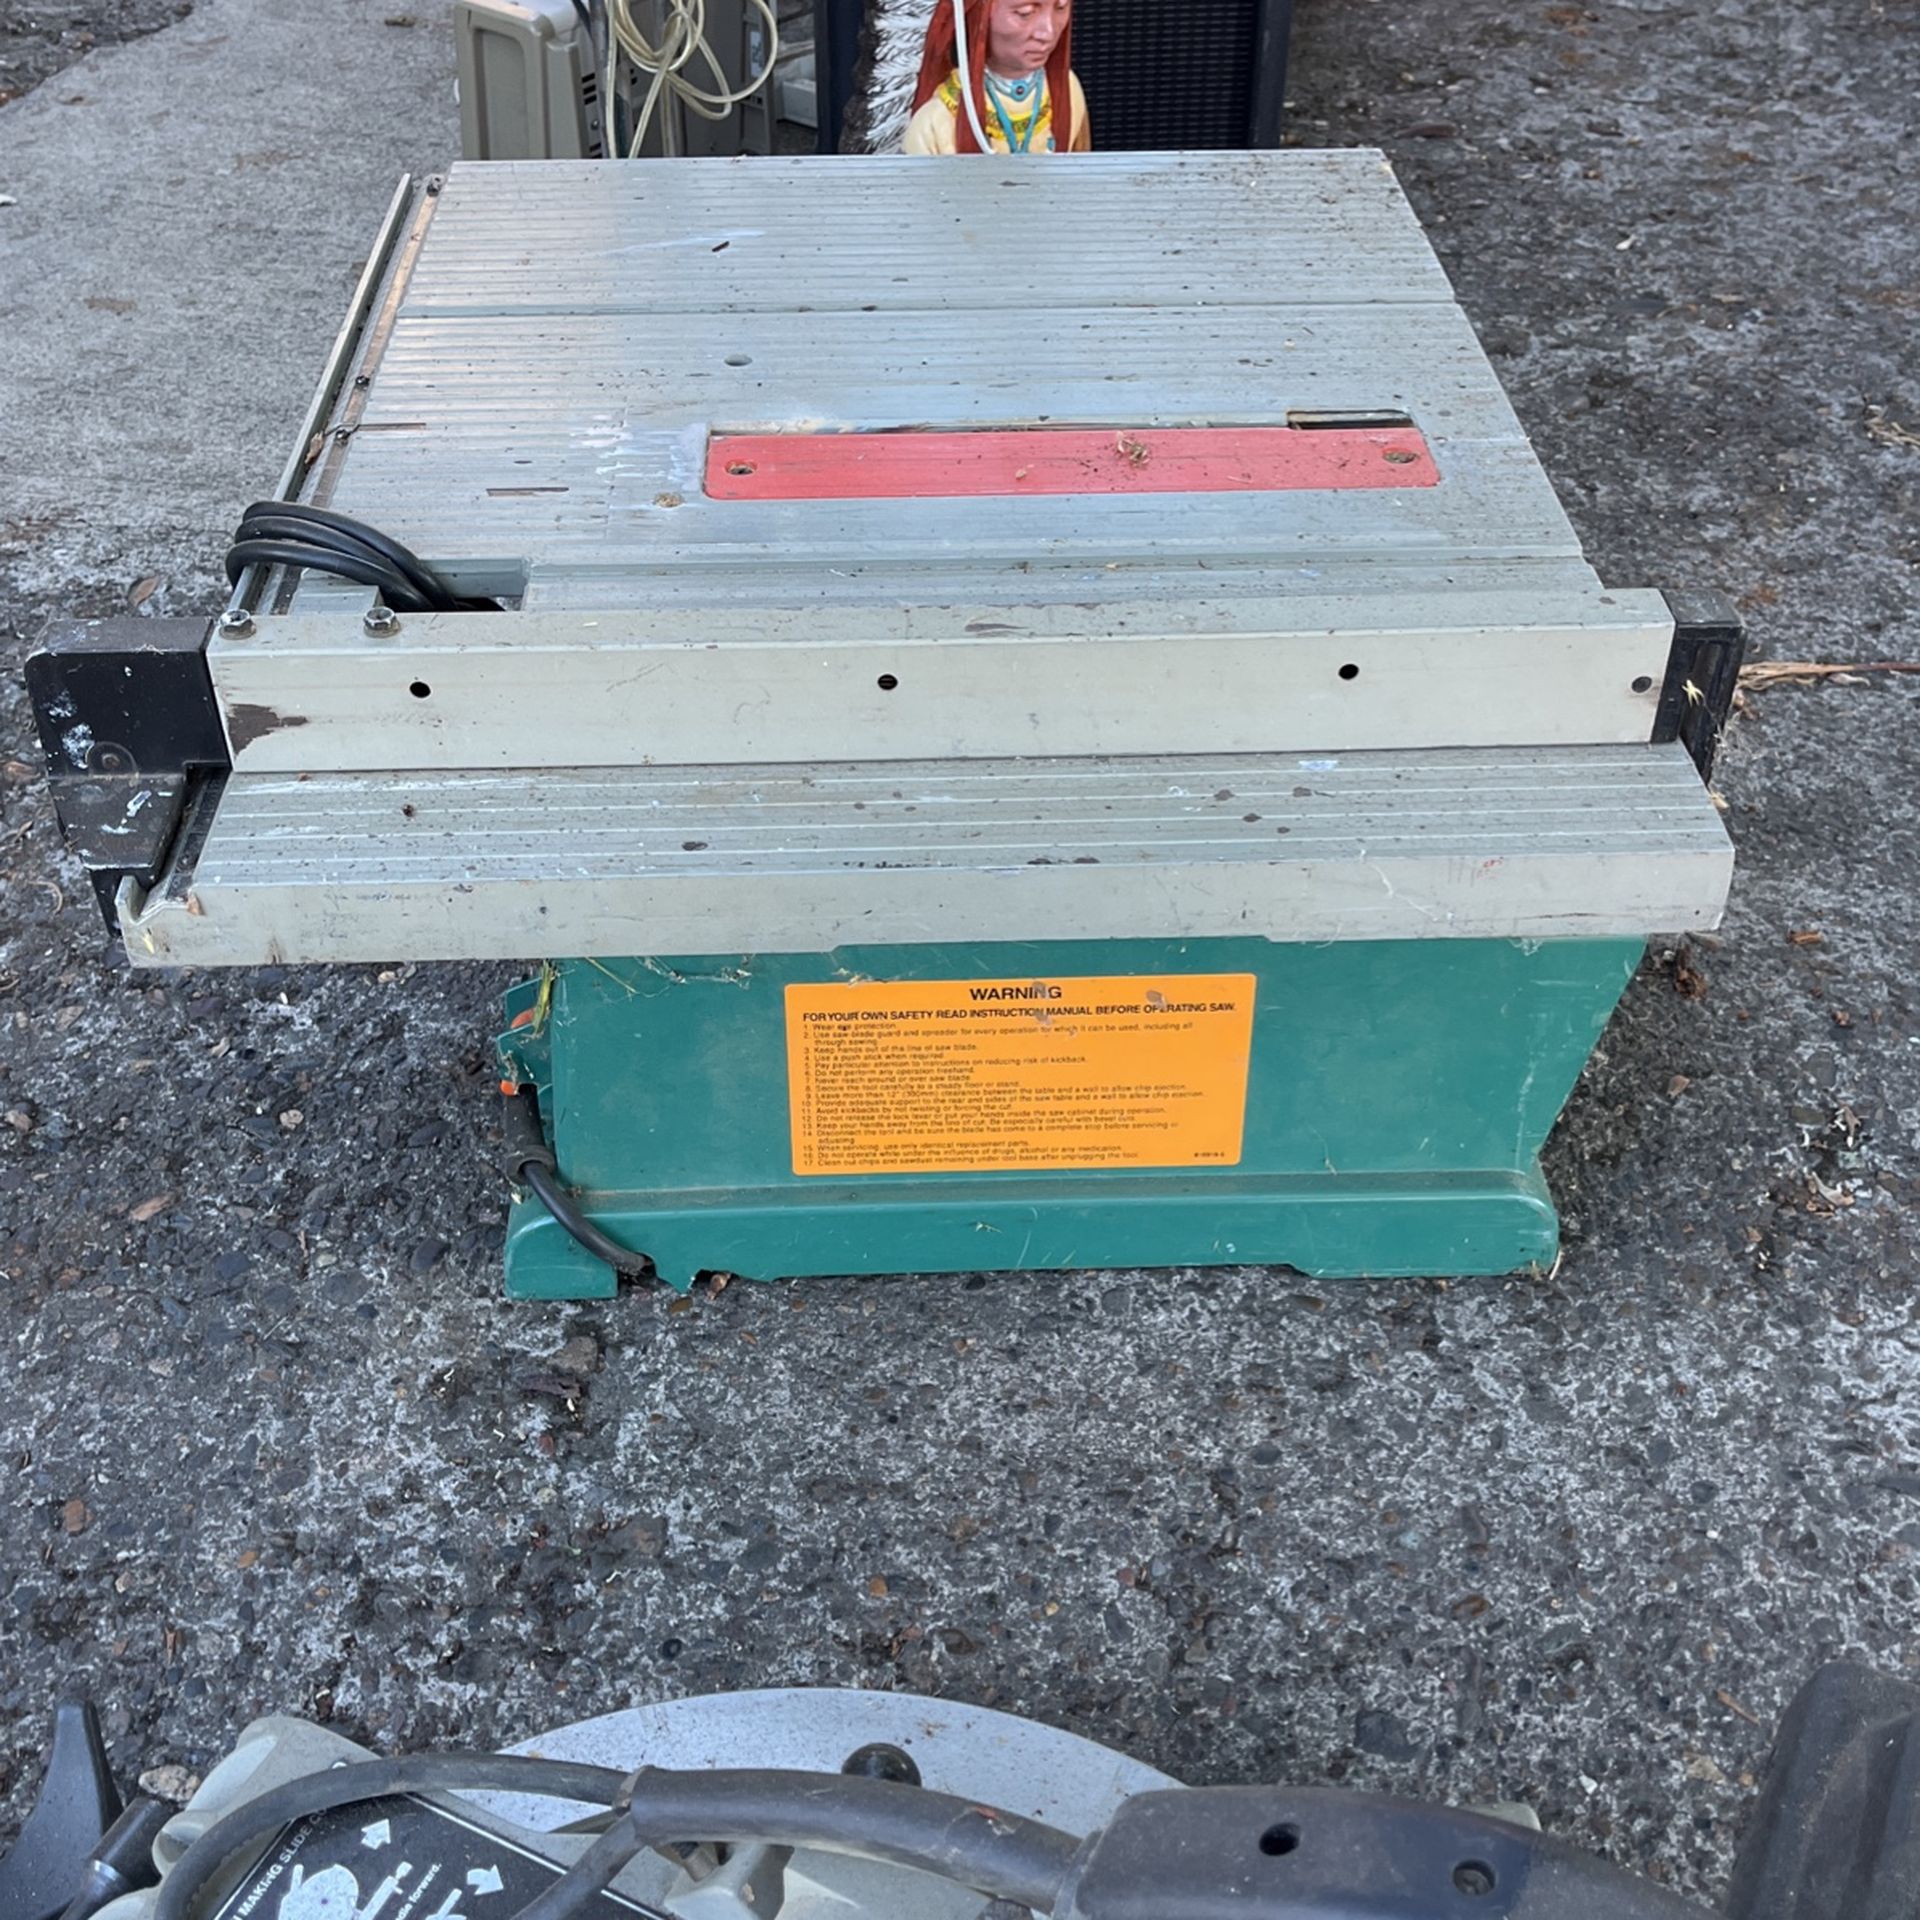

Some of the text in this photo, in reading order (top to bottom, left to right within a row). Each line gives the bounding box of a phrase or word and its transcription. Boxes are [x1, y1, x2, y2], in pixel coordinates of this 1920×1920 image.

[969, 986, 1062, 1000] WARNING
[802, 1013, 826, 1022] FOR
[827, 1012, 858, 1021] YOUR
[860, 1011, 888, 1020] OWN
[890, 1010, 933, 1019] SAFETY
[935, 1009, 967, 1018] READ
[1045, 1006, 1092, 1015] MANUAL
[1095, 1004, 1140, 1014] BEFORE
[237, 1825, 313, 1916] MAKING SLIDE
[408, 1863, 442, 1903] forward.
